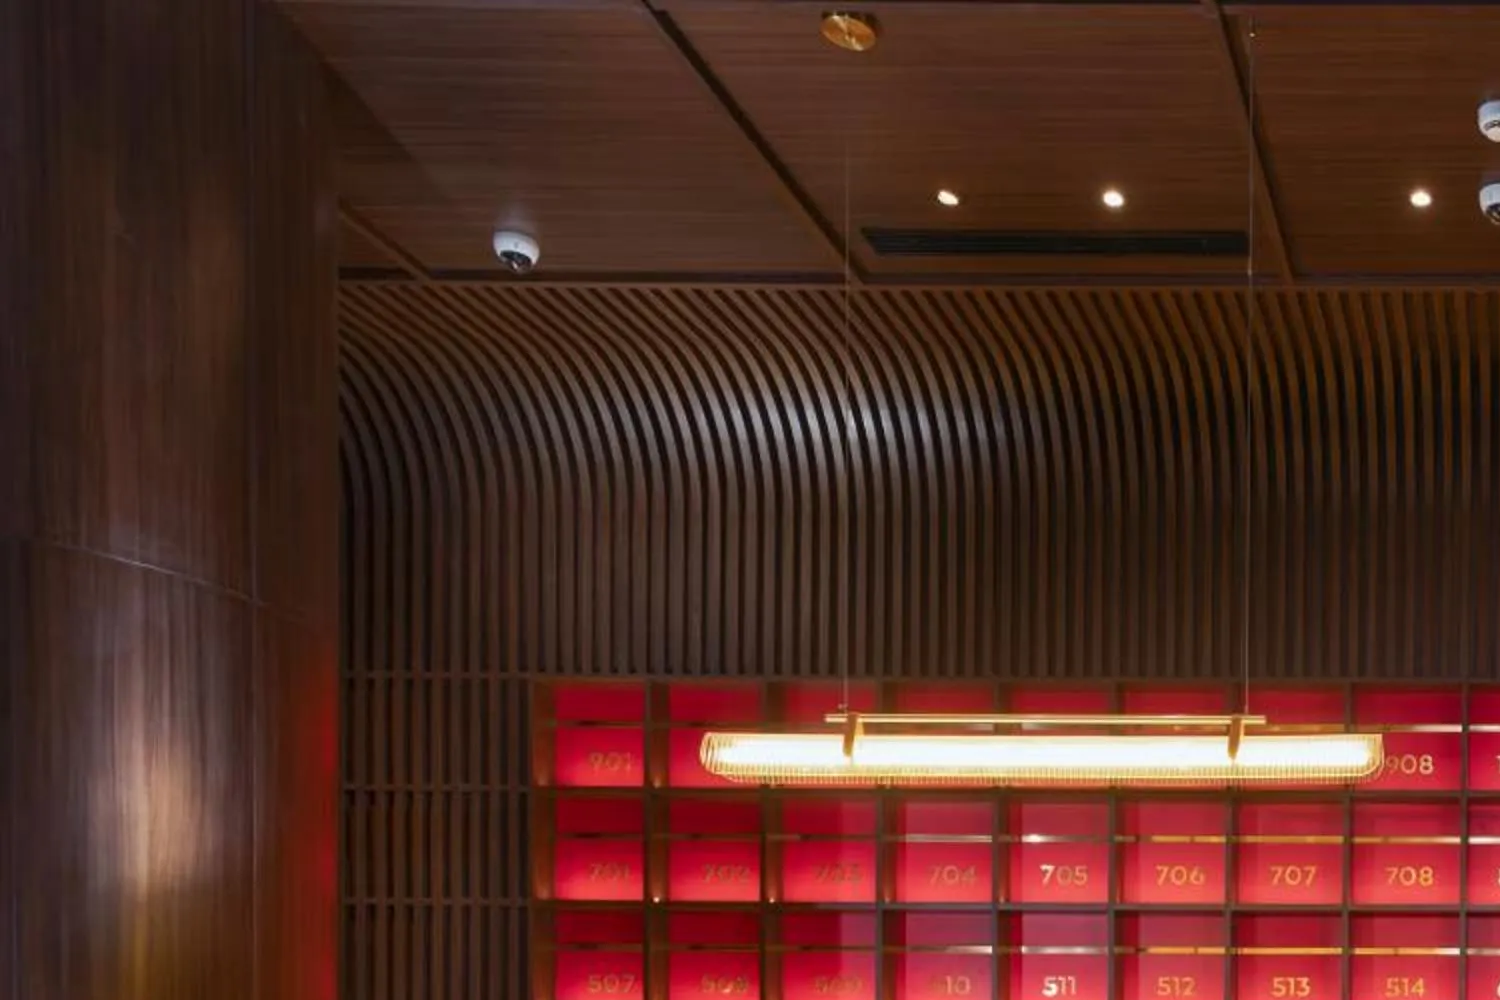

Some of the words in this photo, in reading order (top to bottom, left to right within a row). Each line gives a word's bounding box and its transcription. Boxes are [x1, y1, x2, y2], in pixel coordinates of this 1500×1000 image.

[1385, 753, 1434, 775] 908
[928, 864, 976, 886] 704
[1039, 864, 1089, 886] 705
[1155, 865, 1207, 887] 706
[1269, 866, 1317, 887] 707
[1386, 866, 1434, 887] 708
[931, 975, 972, 996] 10
[1040, 975, 1078, 998] 511
[1155, 976, 1196, 998] 512
[1270, 976, 1312, 998] 513
[1385, 977, 1425, 999] 514
